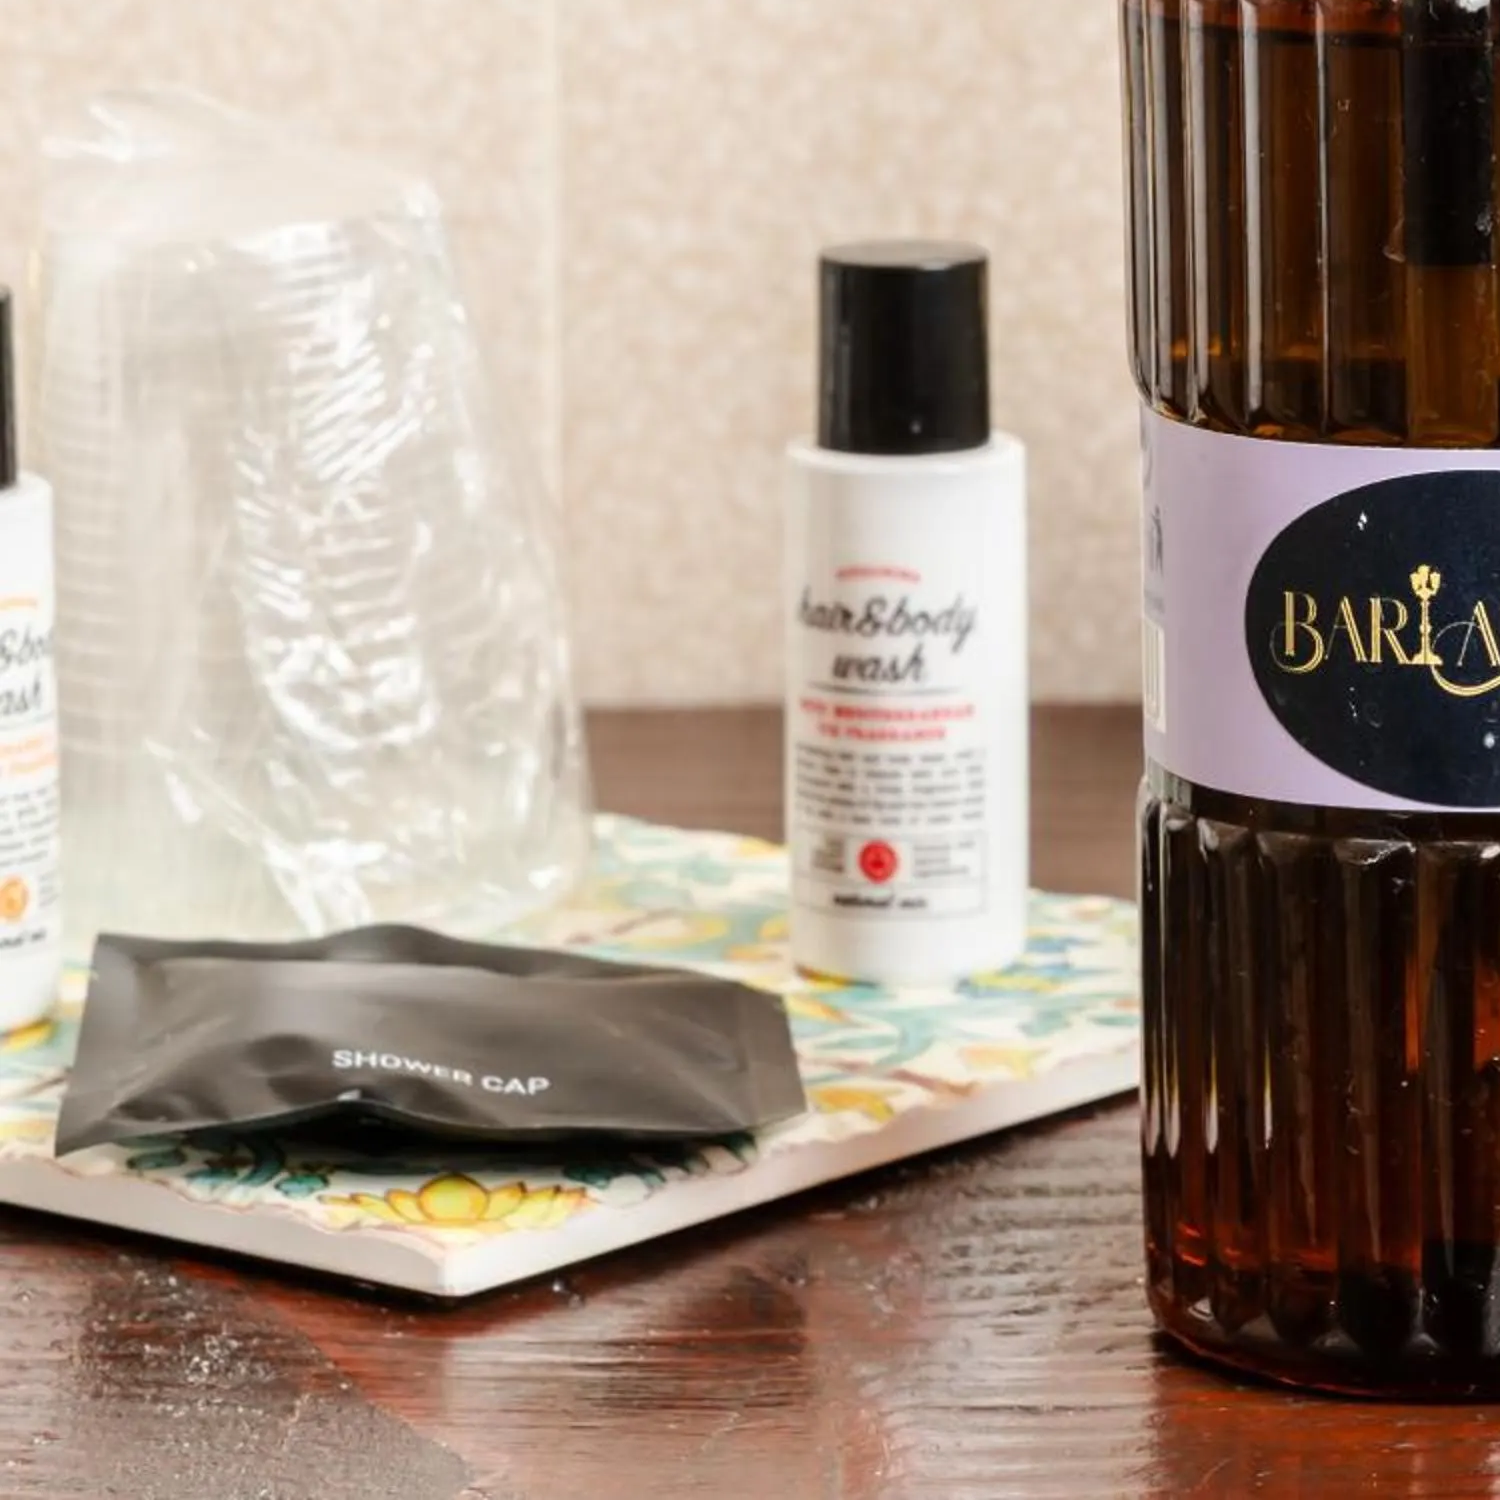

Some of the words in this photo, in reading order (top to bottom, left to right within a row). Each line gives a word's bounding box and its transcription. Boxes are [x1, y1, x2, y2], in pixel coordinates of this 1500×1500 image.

[832, 642, 925, 681] wash
[332, 1049, 473, 1086] SHOWER
[480, 1074, 551, 1096] CAP
